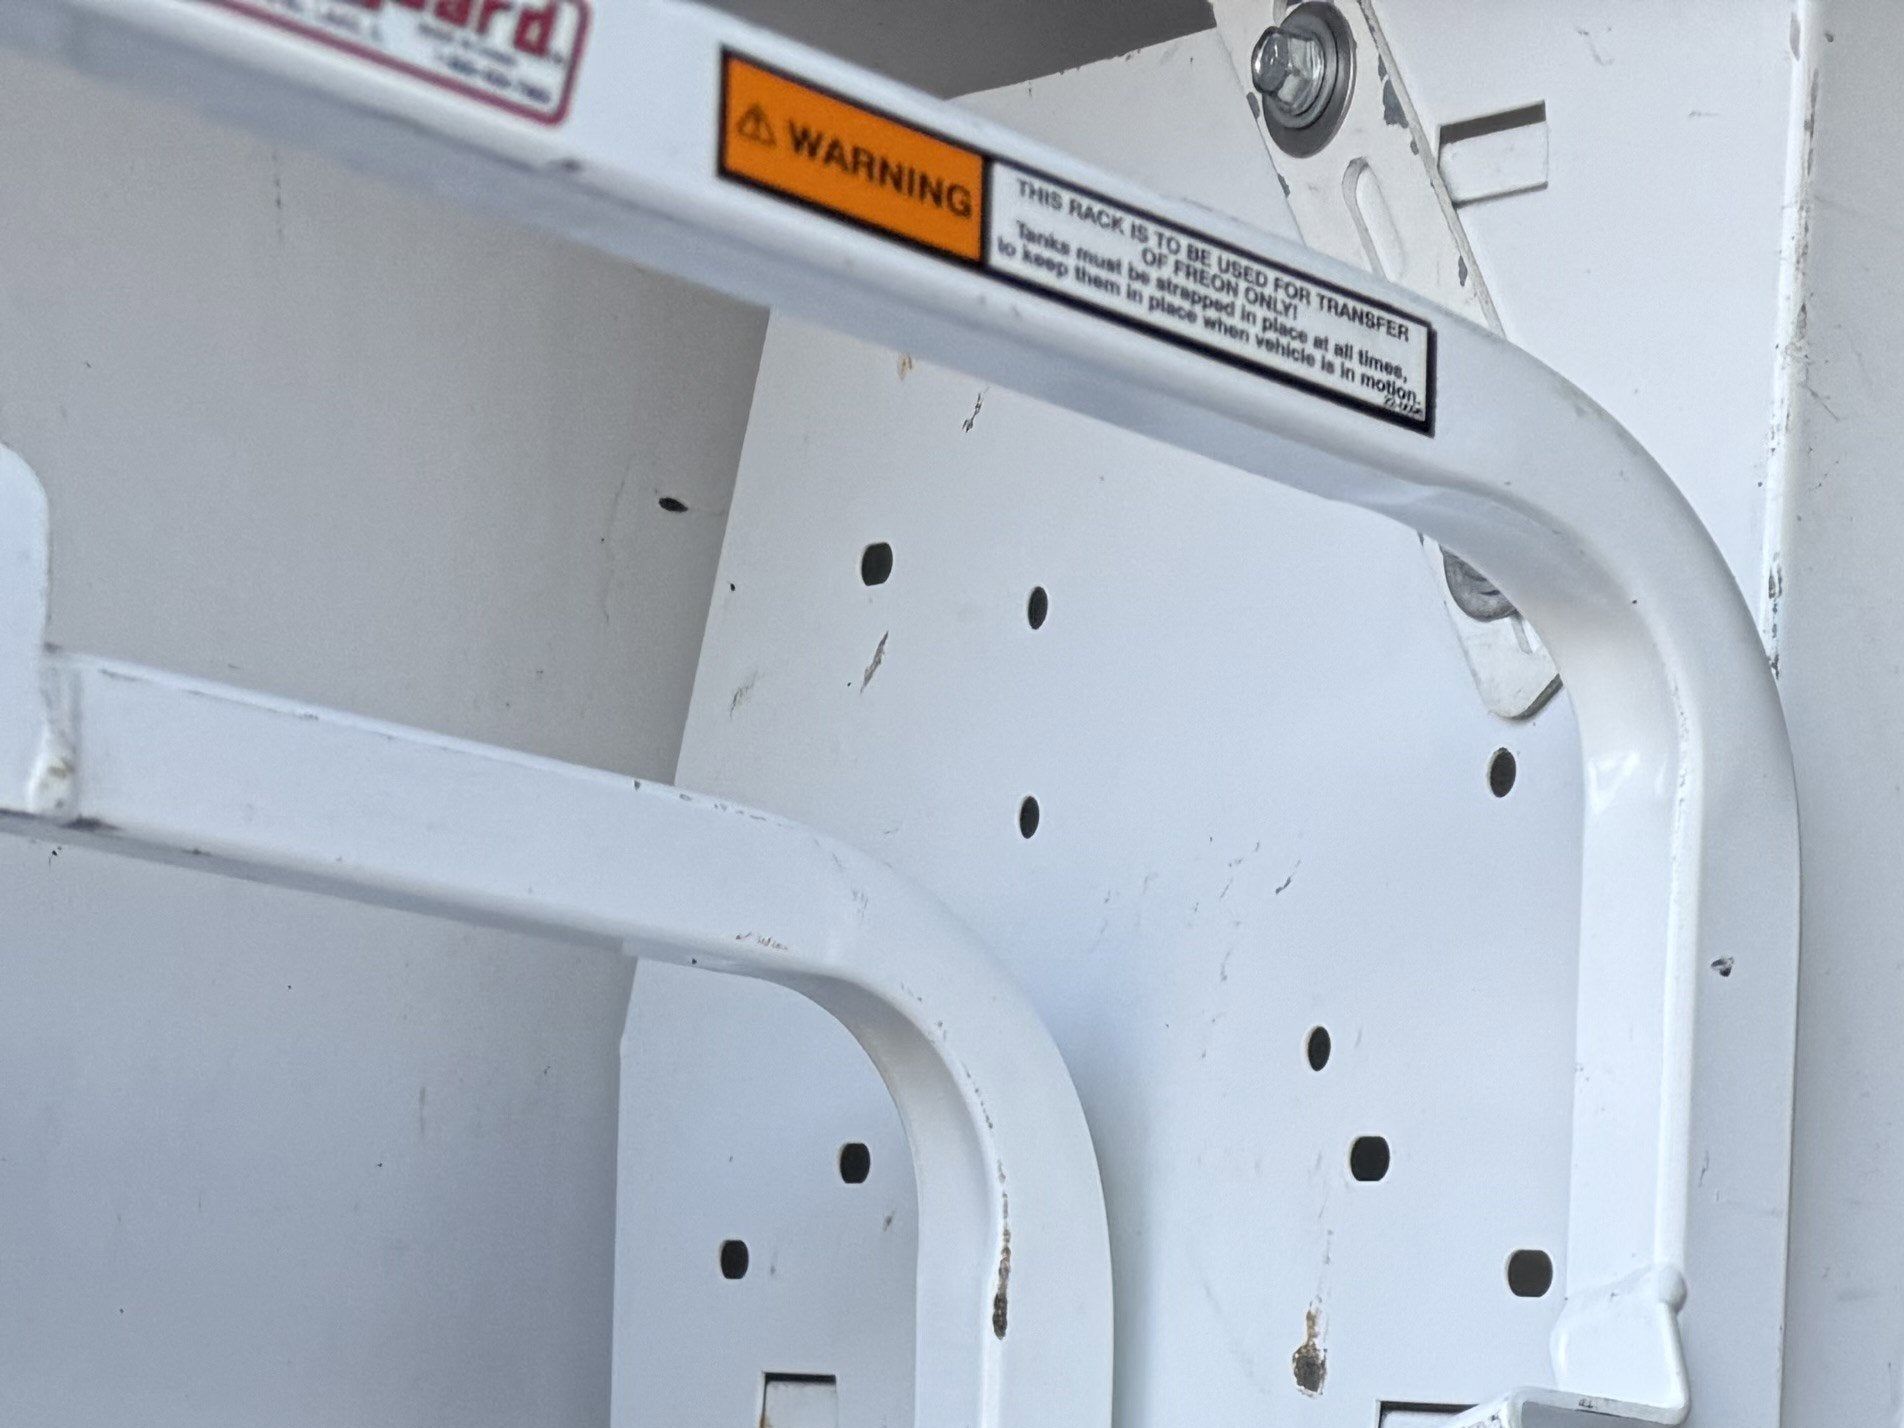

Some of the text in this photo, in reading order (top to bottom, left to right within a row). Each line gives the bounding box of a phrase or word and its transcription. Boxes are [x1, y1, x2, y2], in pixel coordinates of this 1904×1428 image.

[788, 118, 973, 219] WARNING
[997, 235, 1017, 257] to
[1021, 243, 1069, 279] keep
[1074, 264, 1121, 297] them
[1126, 282, 1143, 306] in
[1147, 293, 1198, 324] place
[1203, 314, 1250, 344] when
[1255, 331, 1316, 368] vehicle
[1320, 354, 1336, 375] is
[1340, 361, 1355, 383] in
[1360, 371, 1421, 406] motion.
[1016, 219, 1408, 383] Tanks must be strapped in place at all times,
[1017, 178, 1410, 342] THIS RACK IS TO BE USED FOR TRANSFER
[1141, 246, 1299, 321] OF FREON ONLY!
